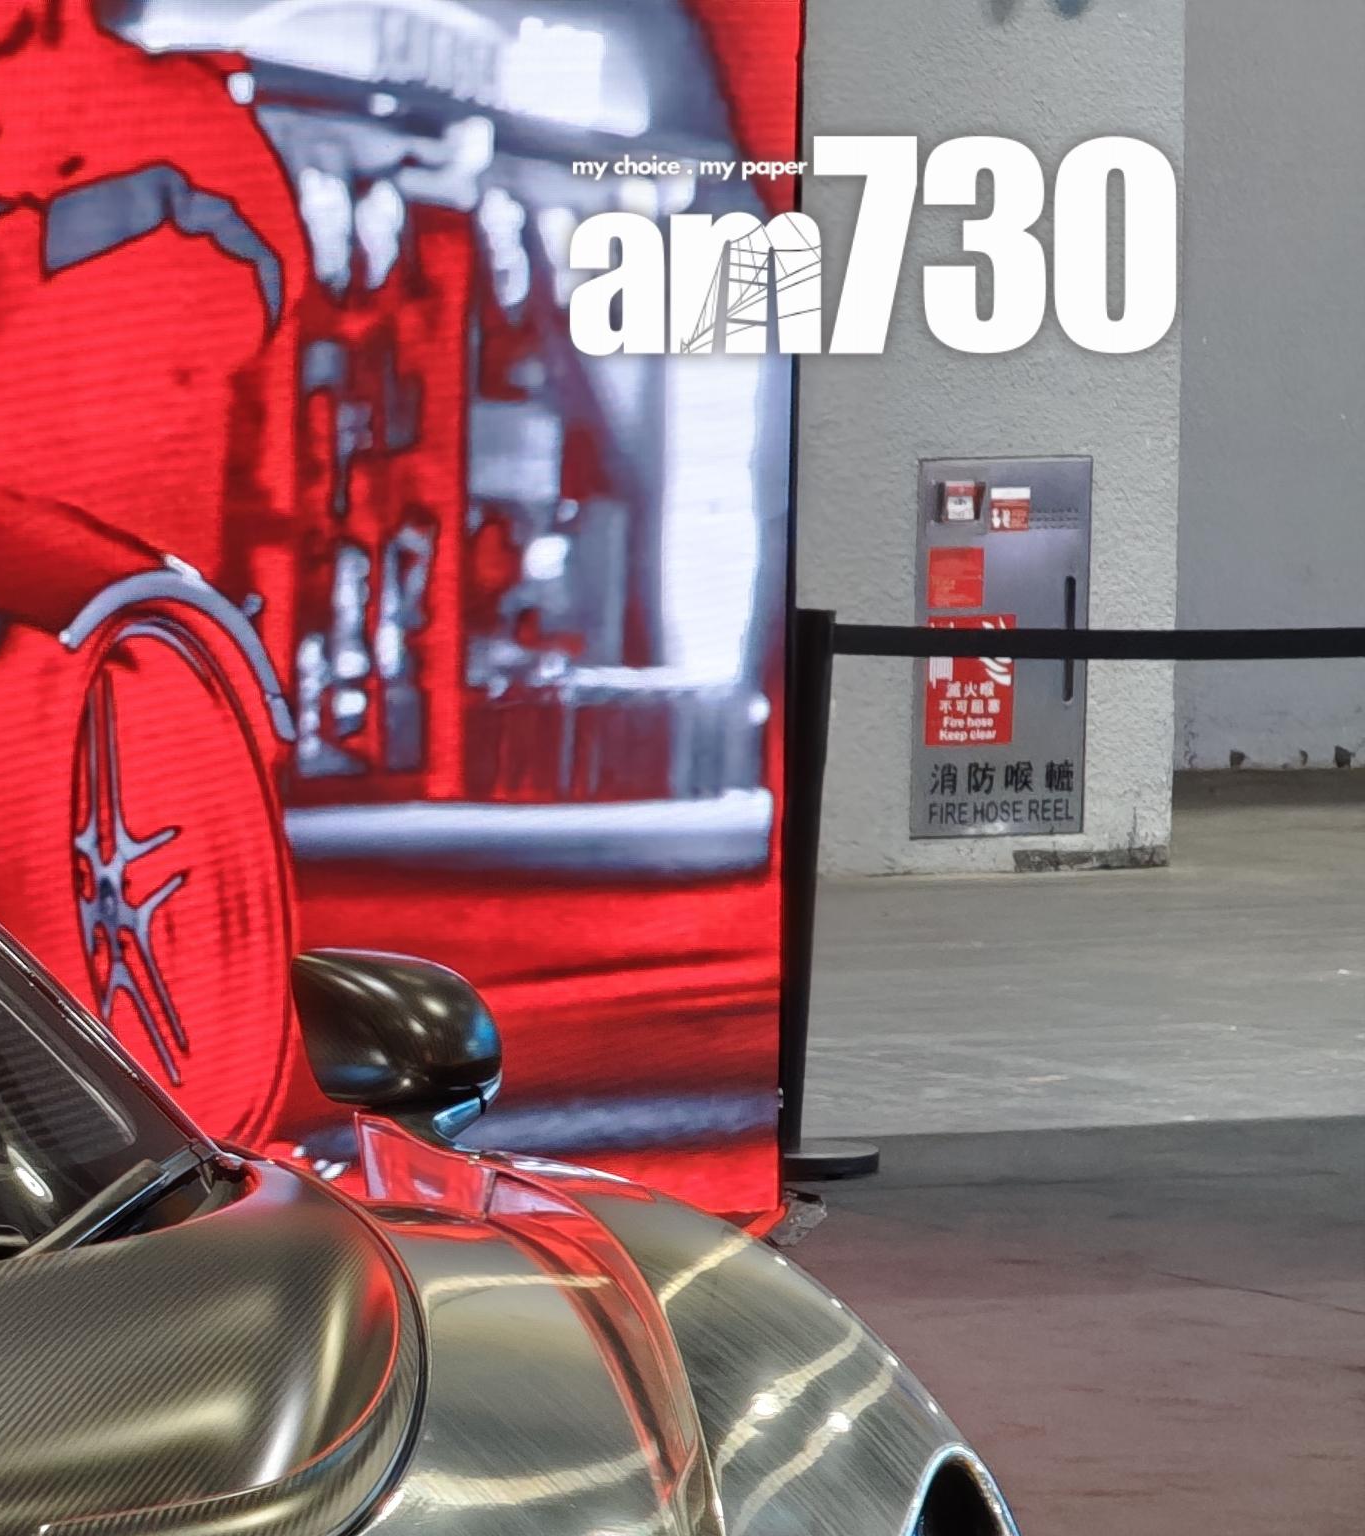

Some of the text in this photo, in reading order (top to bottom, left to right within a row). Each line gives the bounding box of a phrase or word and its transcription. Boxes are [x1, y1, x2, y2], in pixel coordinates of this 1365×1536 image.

[942, 716, 994, 728] Fire hose
[939, 729, 997, 742] Keep clear
[928, 798, 1074, 825] FIRE HOSE REEL
